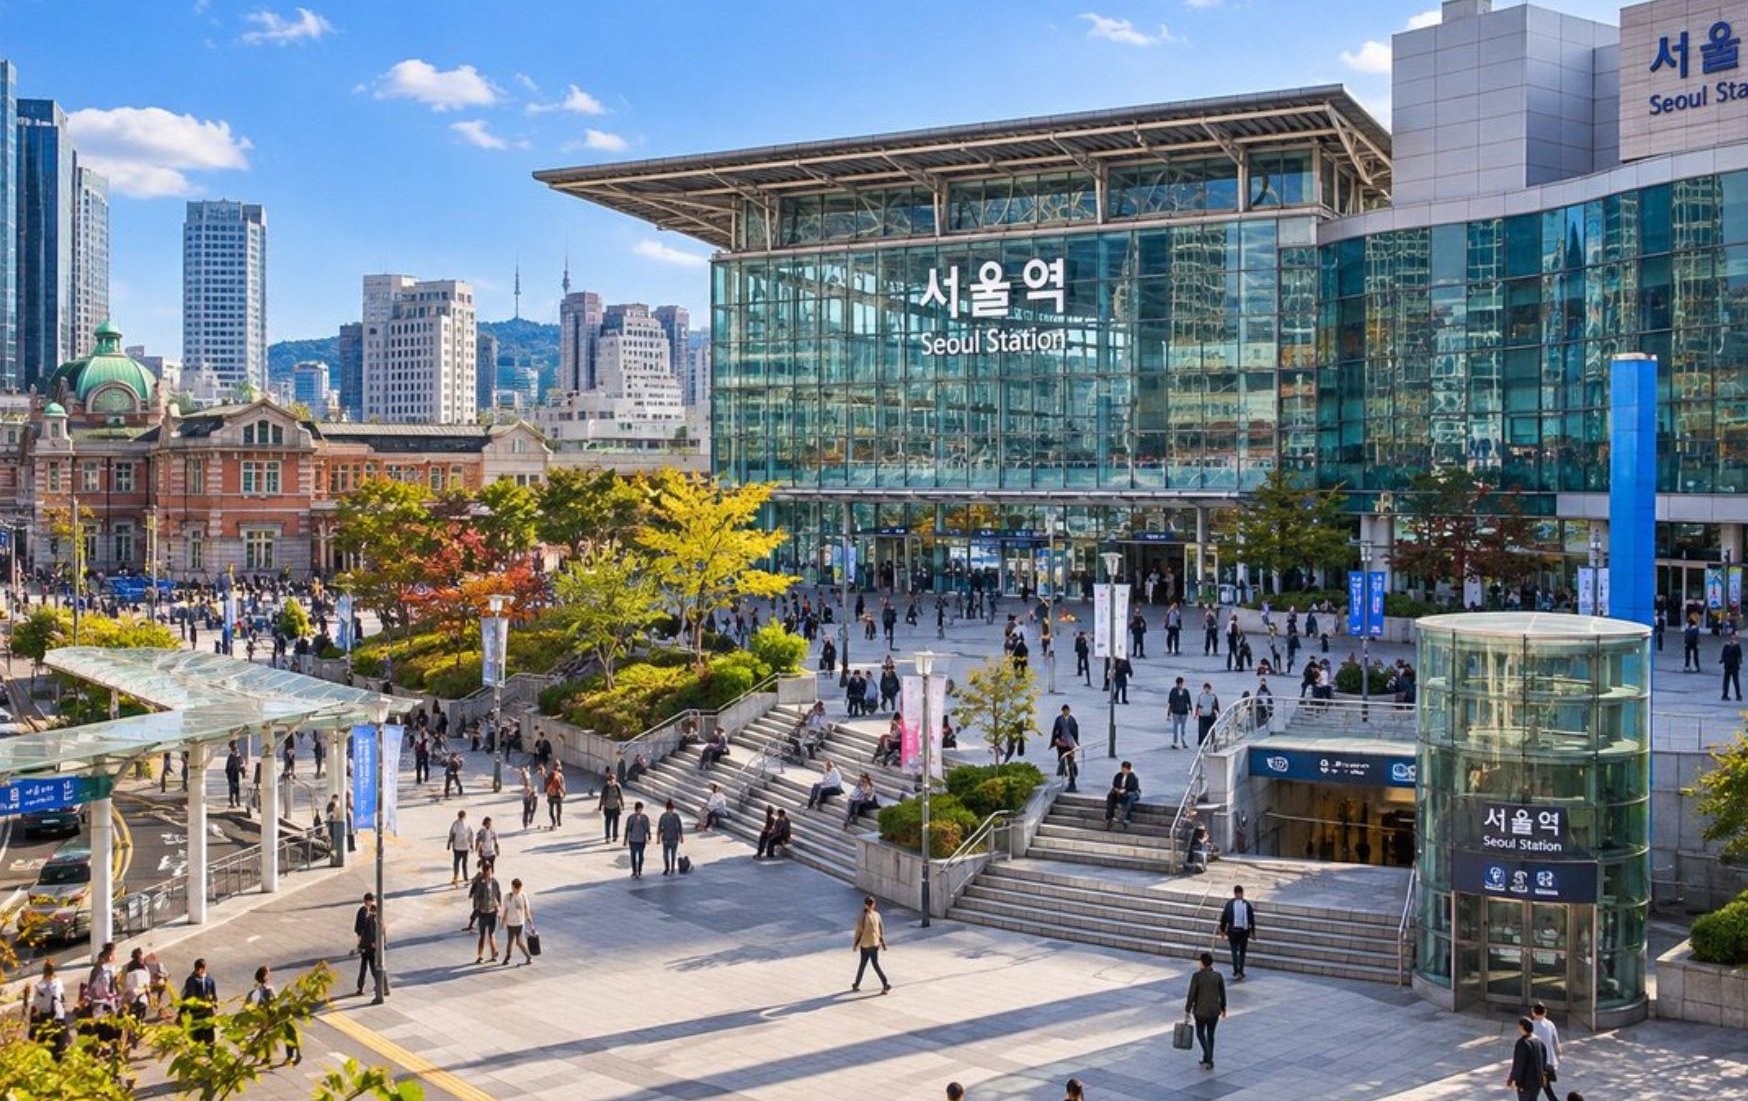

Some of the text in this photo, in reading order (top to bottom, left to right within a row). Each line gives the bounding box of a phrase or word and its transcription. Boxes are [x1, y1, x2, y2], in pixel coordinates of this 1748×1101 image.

[1650, 21, 1740, 79] 서울
[1649, 85, 1707, 115] Seoul
[920, 258, 1064, 319] 서울역
[921, 326, 1066, 355] Seoul Station
[1484, 808, 1560, 836] 서울역
[1483, 835, 1562, 852] Seoul Station
